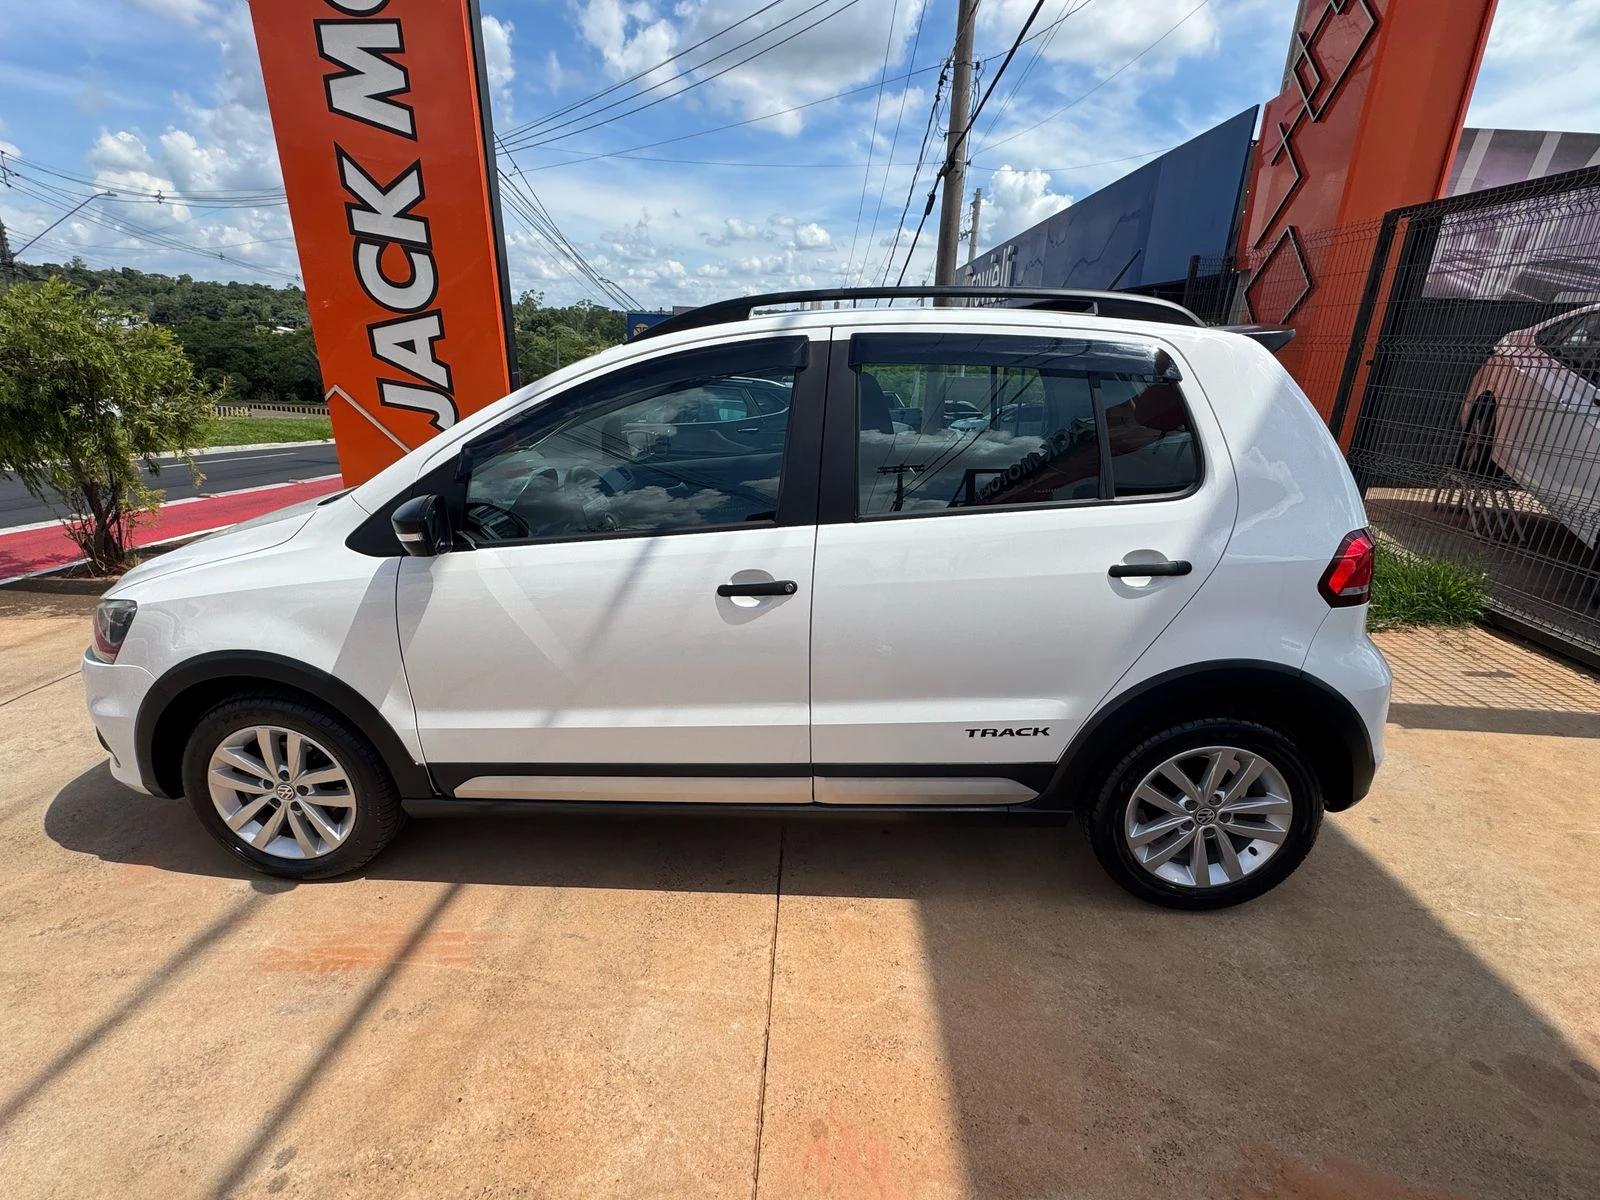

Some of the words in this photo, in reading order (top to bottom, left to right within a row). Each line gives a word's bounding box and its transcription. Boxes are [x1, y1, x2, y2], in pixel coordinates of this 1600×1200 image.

[313, 0, 418, 141] M
[334, 141, 459, 431] JACK
[965, 727, 1050, 738] TRACK
